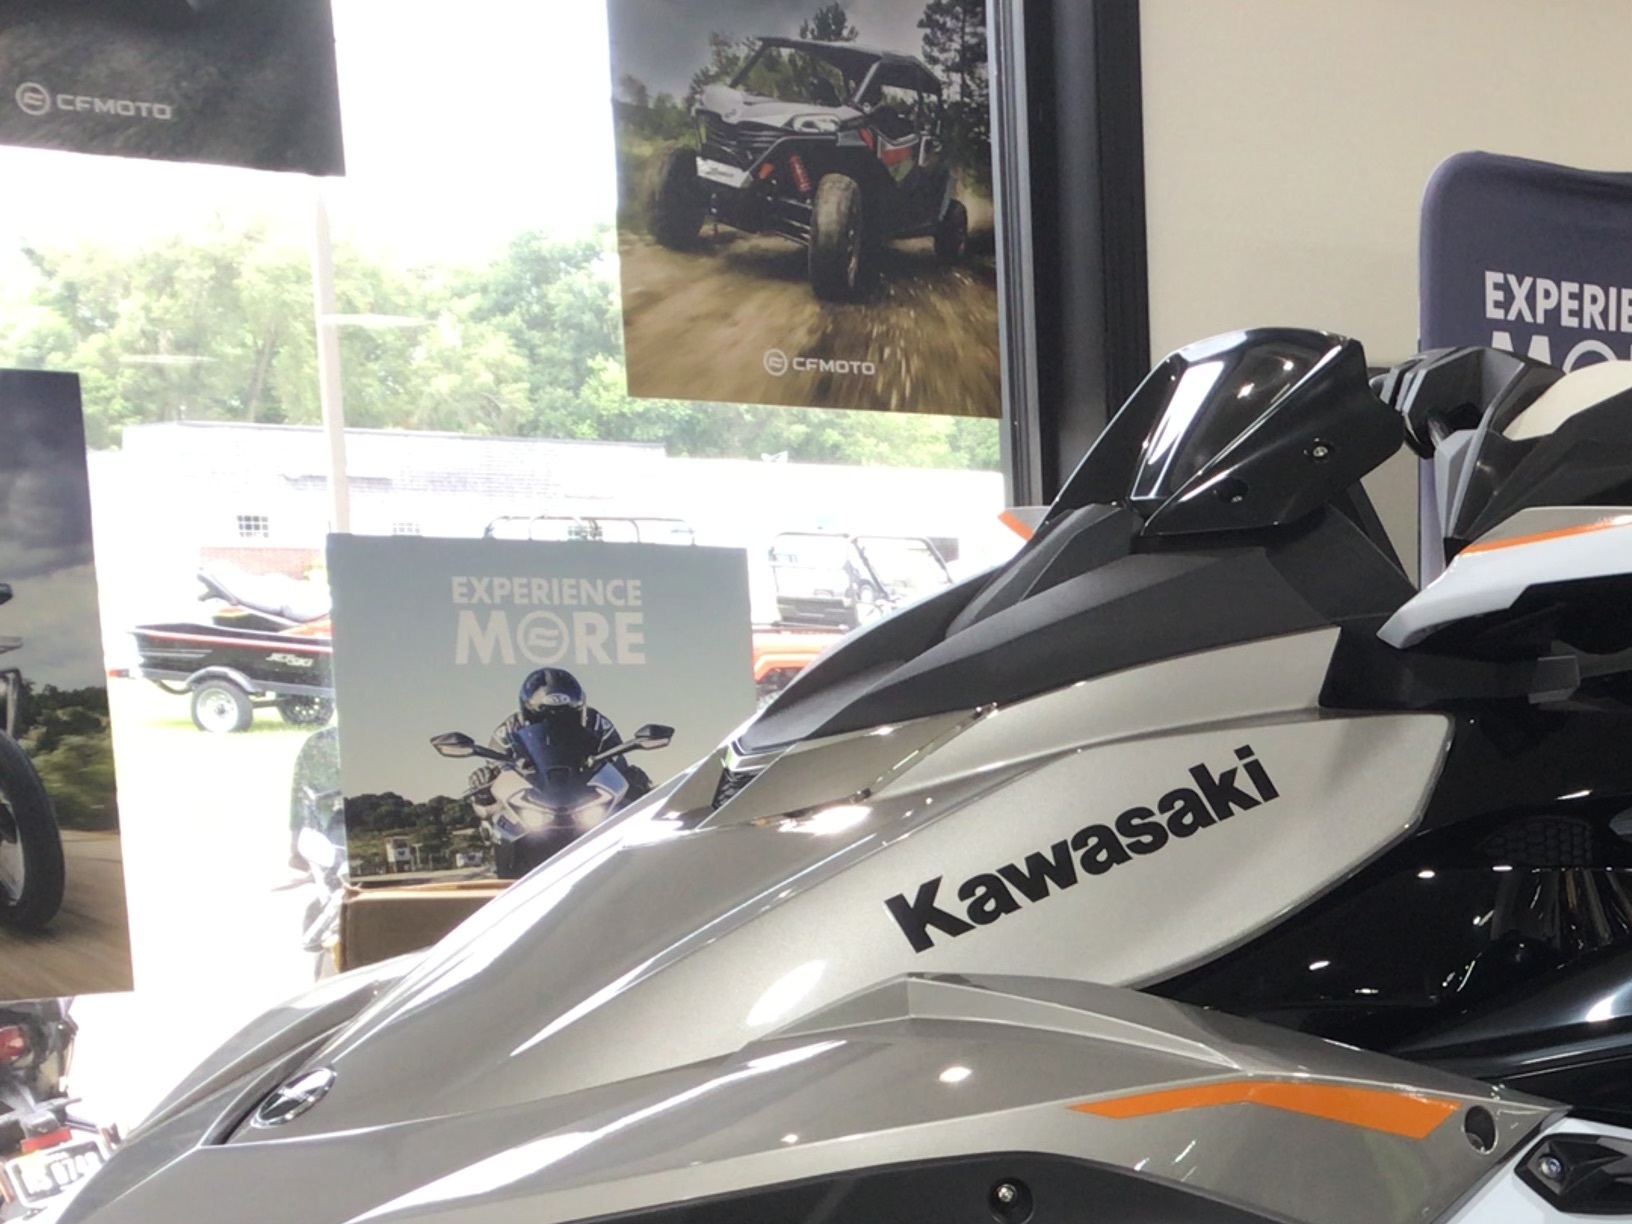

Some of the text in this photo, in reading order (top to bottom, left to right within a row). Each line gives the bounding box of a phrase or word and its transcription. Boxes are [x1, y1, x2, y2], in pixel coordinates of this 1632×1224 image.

[55, 93, 174, 120] CFMOTO
[792, 357, 876, 375] CFMOTO
[451, 576, 643, 607] EXPERIENCE
[455, 609, 646, 665] MORE
[884, 744, 1280, 954] Kawasaki
